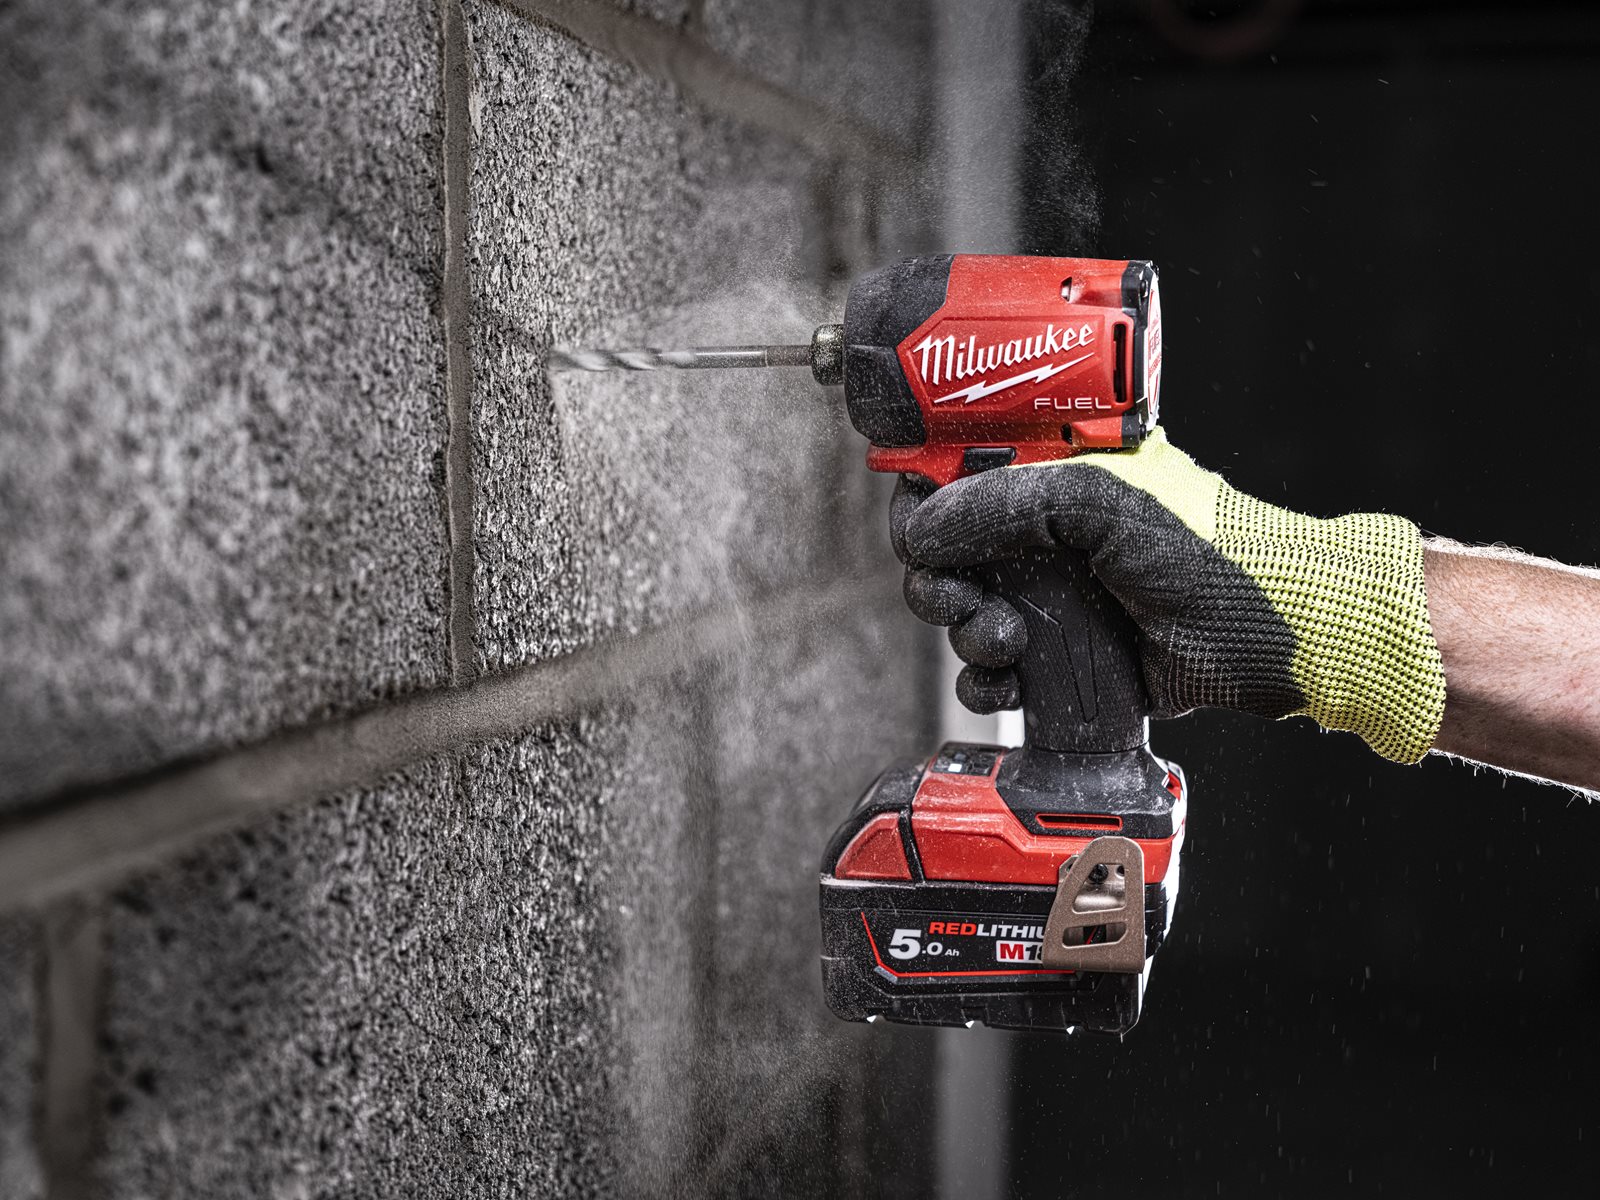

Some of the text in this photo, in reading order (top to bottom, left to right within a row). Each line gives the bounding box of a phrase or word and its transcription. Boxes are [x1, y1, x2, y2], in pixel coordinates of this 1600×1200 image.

[912, 324, 1095, 386] Milwaukee
[1034, 397, 1112, 410] FUEL
[928, 921, 1045, 939] REDLITHIU
[888, 929, 960, 960] 5.0 Ah
